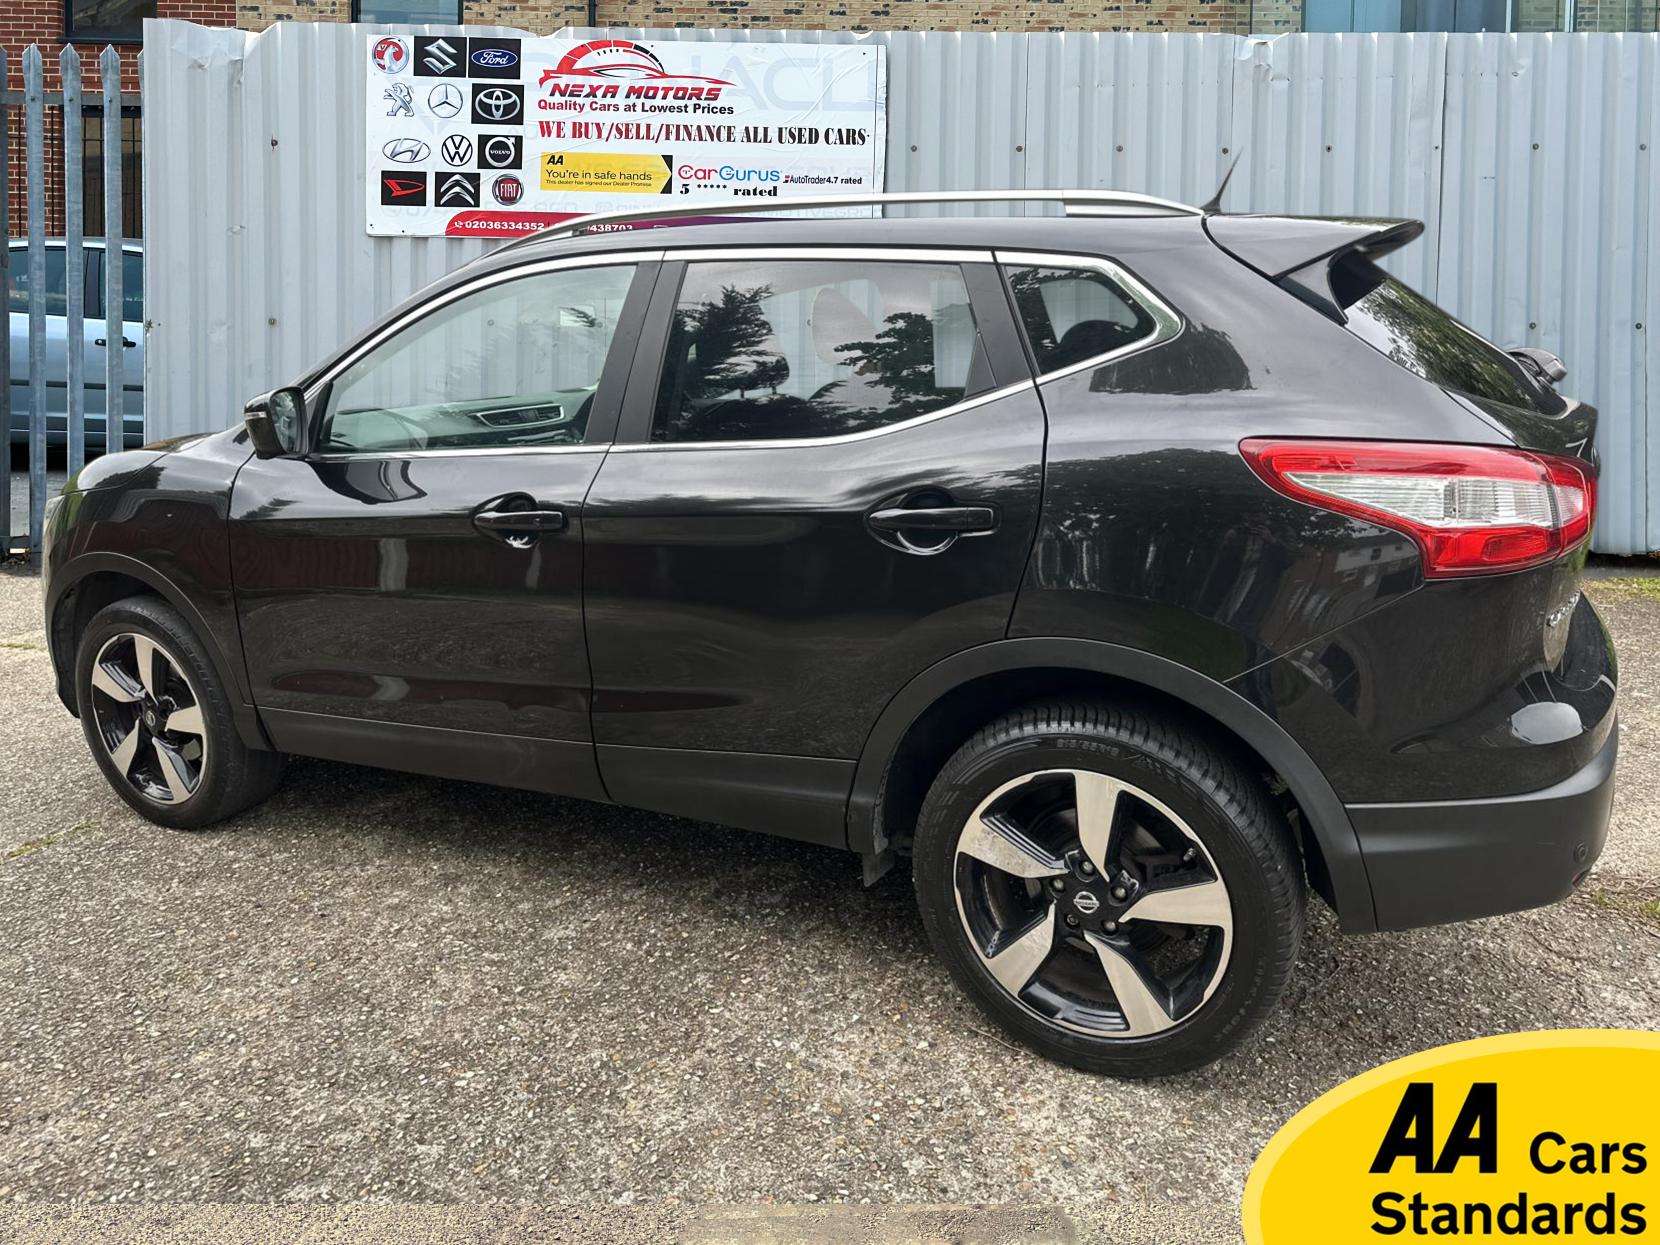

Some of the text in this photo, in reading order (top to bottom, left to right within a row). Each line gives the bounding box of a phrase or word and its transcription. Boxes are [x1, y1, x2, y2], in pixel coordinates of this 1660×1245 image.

[480, 51, 508, 64] Ford
[549, 84, 722, 101] NEXA MOTORS
[538, 100, 734, 114] Quality Cars at Lowest Prices
[538, 121, 566, 138] WE
[741, 126, 772, 144] ALL
[778, 127, 820, 144] USED
[547, 154, 564, 165] AA
[546, 169, 652, 181] You're in safe hands
[678, 165, 780, 182] CarGurus
[840, 177, 862, 185] rated
[500, 184, 517, 198] FIAT
[680, 184, 778, 197] 5 rated
[464, 221, 545, 230] 02036334352
